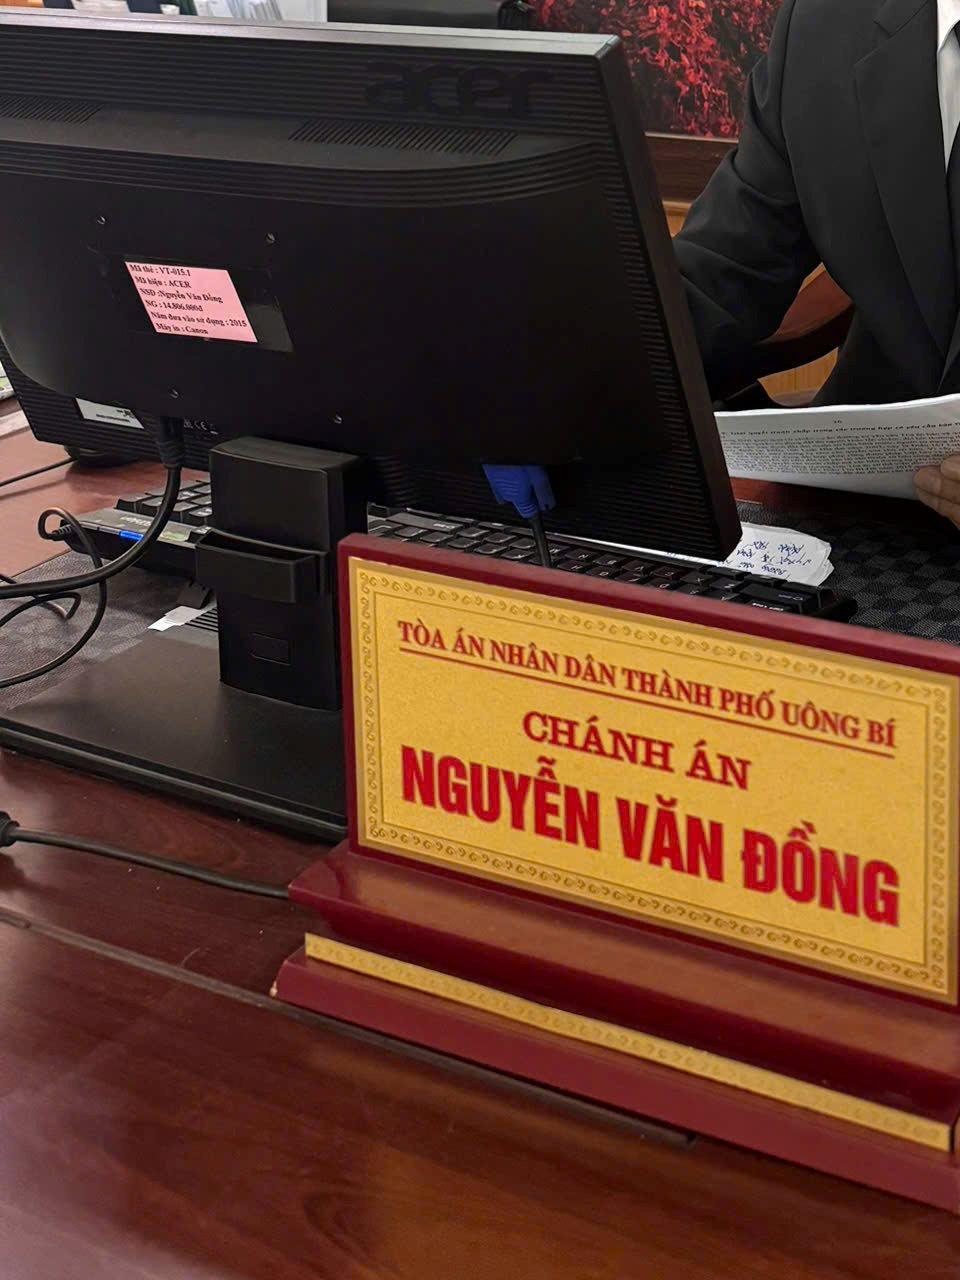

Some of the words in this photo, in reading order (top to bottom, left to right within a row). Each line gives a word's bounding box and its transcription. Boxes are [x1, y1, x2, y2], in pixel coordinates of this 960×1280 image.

[366, 61, 554, 117] acer
[168, 280, 191, 289] ACER
[185, 325, 209, 334] Canon
[230, 319, 247, 327] 2015
[398, 618, 446, 651] TÒA
[452, 627, 485, 658] ÁN
[490, 637, 560, 674] NHÂN
[564, 653, 617, 687] DÂN
[621, 667, 714, 709] THÀNH
[718, 687, 775, 721] PHỐ
[780, 701, 861, 740] UÔNG
[866, 718, 897, 749] BÍ
[522, 711, 675, 773] CHÁNH
[685, 739, 752, 790] ÁN
[401, 744, 601, 851] NGUYỄN
[615, 793, 725, 883] VĂN
[740, 819, 900, 928] ĐỒNG
